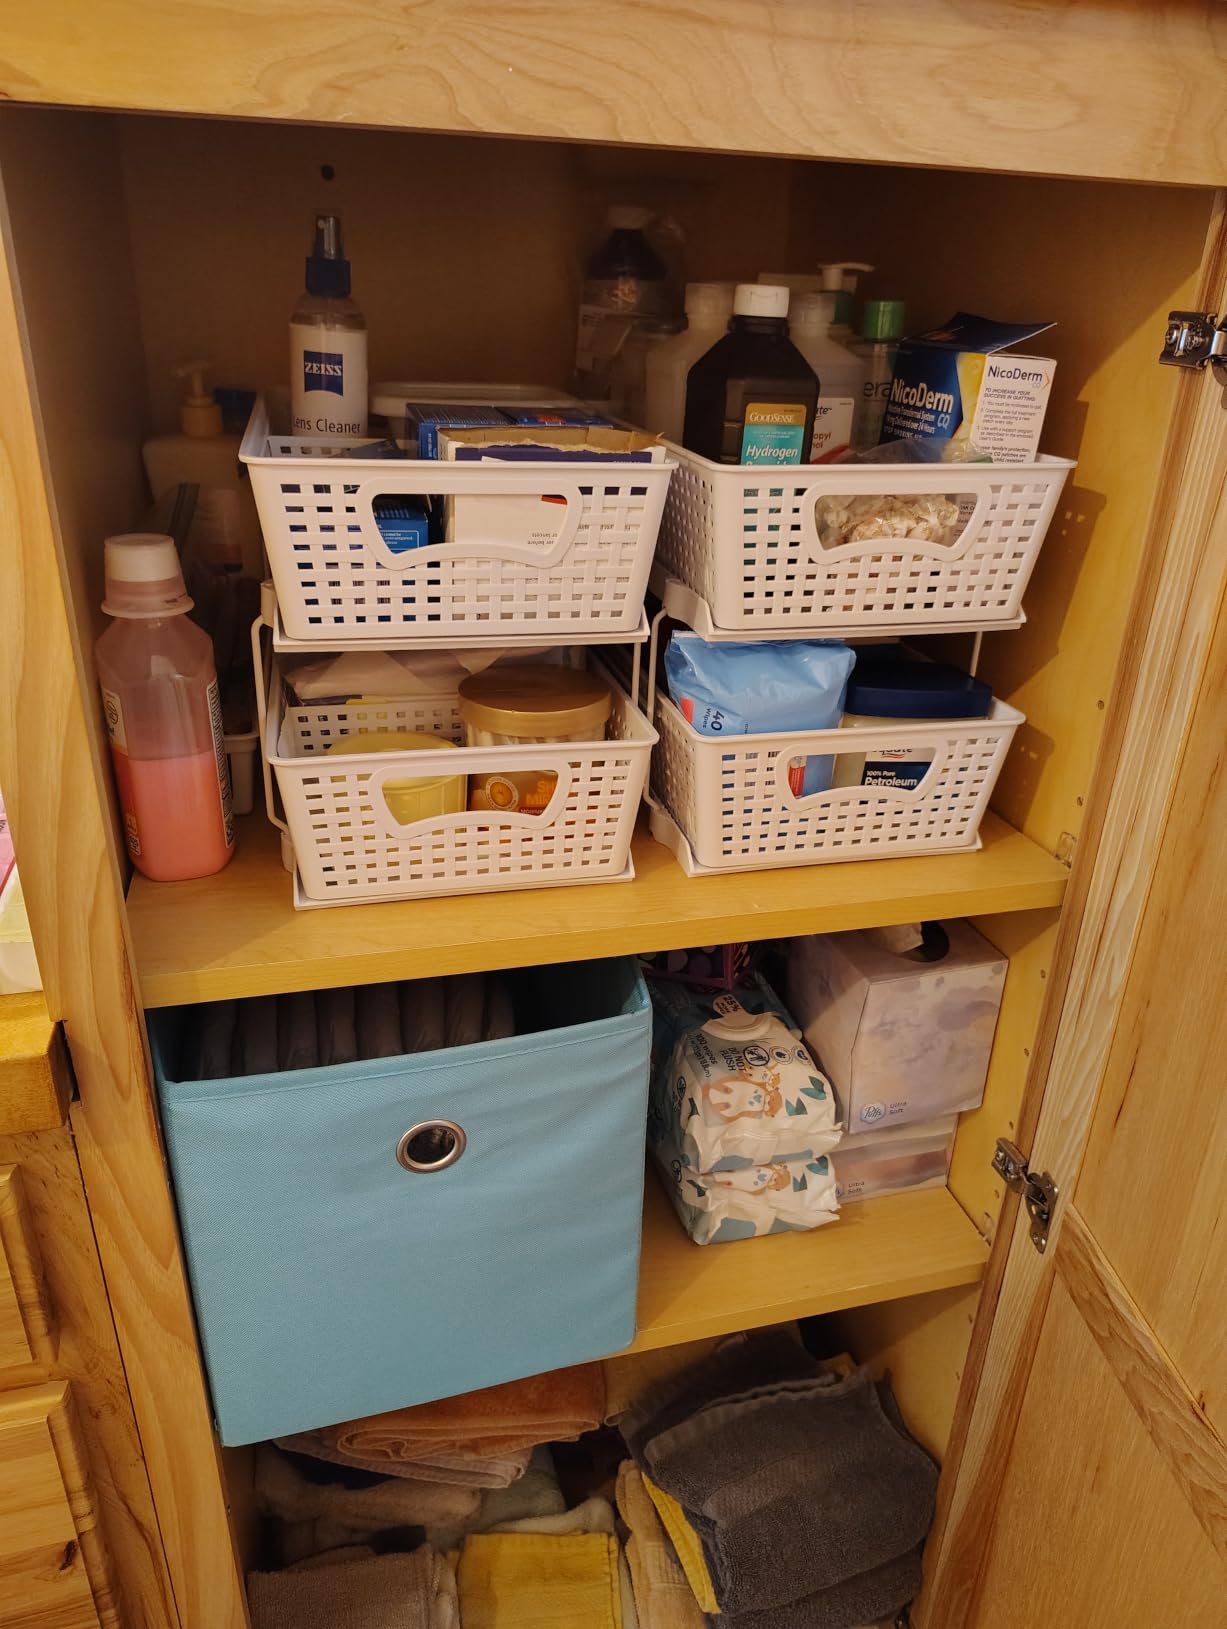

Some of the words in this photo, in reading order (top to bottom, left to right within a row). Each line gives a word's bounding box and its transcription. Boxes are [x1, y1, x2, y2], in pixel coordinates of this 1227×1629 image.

[305, 362, 342, 376] ZEISS
[988, 366, 1043, 382] NicoDerm
[890, 378, 954, 414] NicoDerm
[316, 418, 360, 434] Cleaner
[937, 414, 950, 430] CQ
[813, 432, 832, 440] opyl
[746, 445, 798, 460] Hydrogen
[703, 708, 711, 728] Wipes
[711, 711, 724, 731] 40
[865, 777, 917, 787] Petroleum
[703, 1046, 718, 1065] wipes
[720, 1049, 736, 1072] FLUSH
[736, 1054, 747, 1073] NOT
[864, 1105, 882, 1119] Puffs
